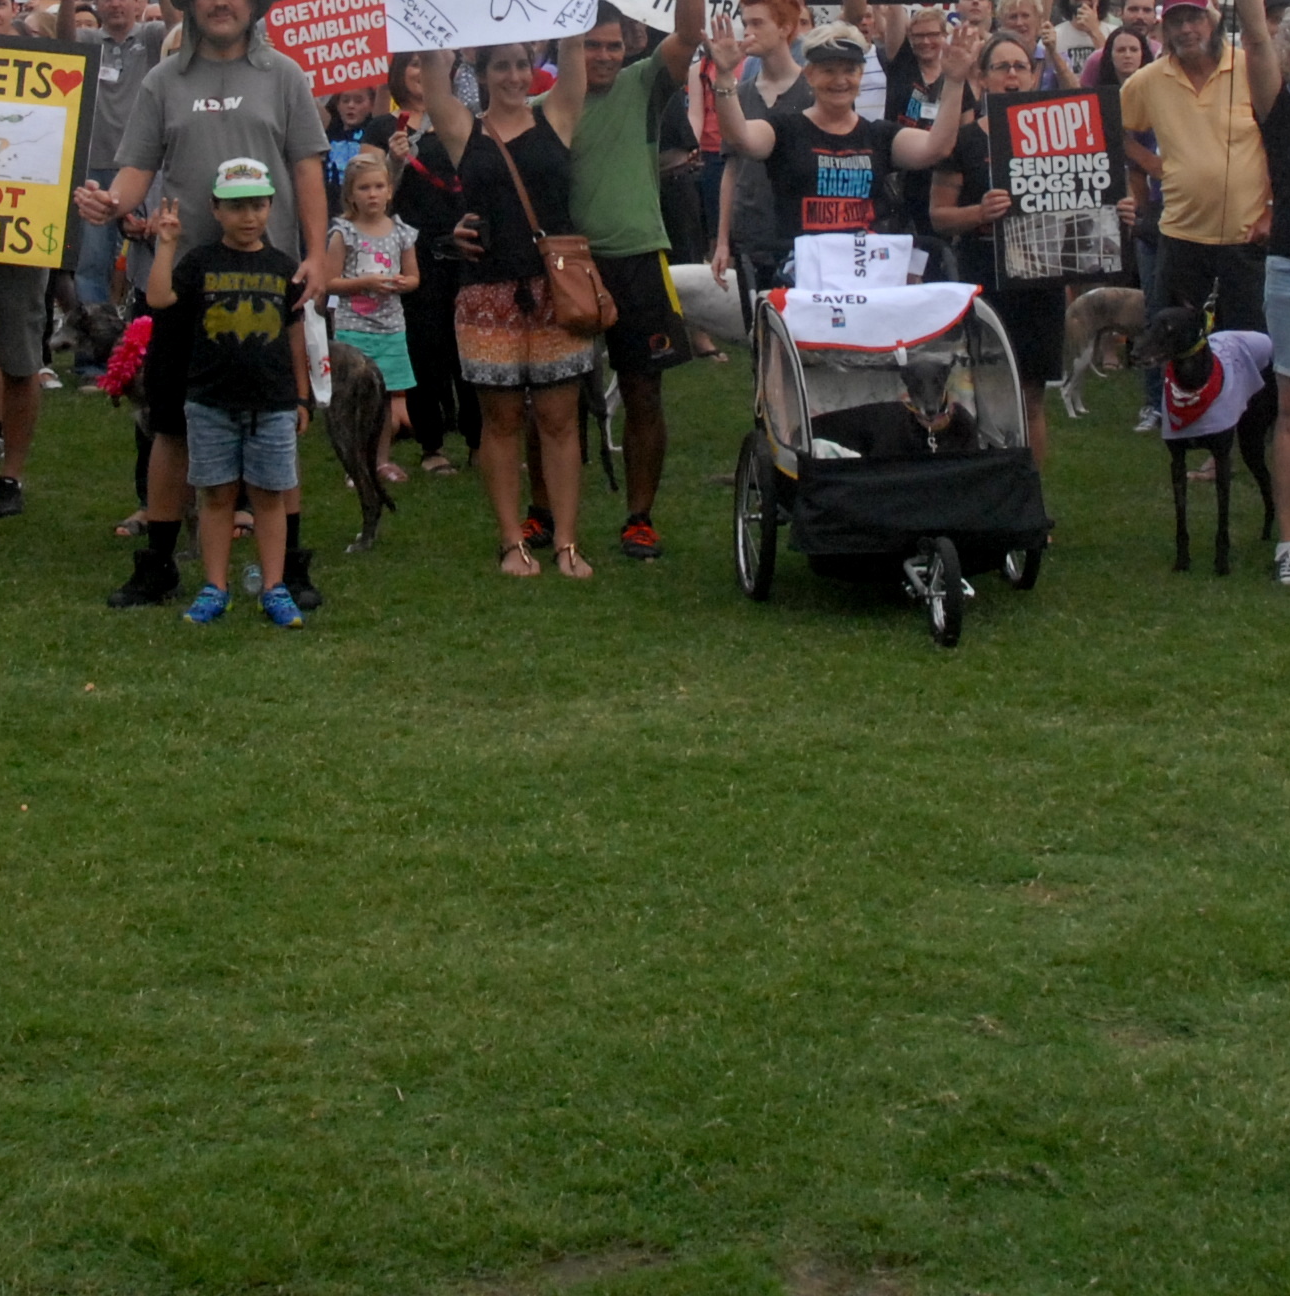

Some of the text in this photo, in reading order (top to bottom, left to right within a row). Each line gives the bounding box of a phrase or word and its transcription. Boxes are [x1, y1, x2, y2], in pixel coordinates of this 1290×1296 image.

[283, 10, 386, 47] GAMBLING
[303, 36, 371, 66] TRACK
[321, 55, 390, 86] LOGAN
[1017, 99, 1095, 156] STOP!
[817, 154, 872, 170] GREYHOUND
[1009, 152, 1110, 177] SENDING
[817, 168, 873, 198] RACING
[1010, 171, 1111, 196] DOGS TO
[806, 200, 838, 224] MUST
[1020, 190, 1103, 214] CHINA!
[854, 230, 869, 278] SAVED
[204, 270, 287, 294] BATMAN
[812, 294, 867, 305] SAVED
